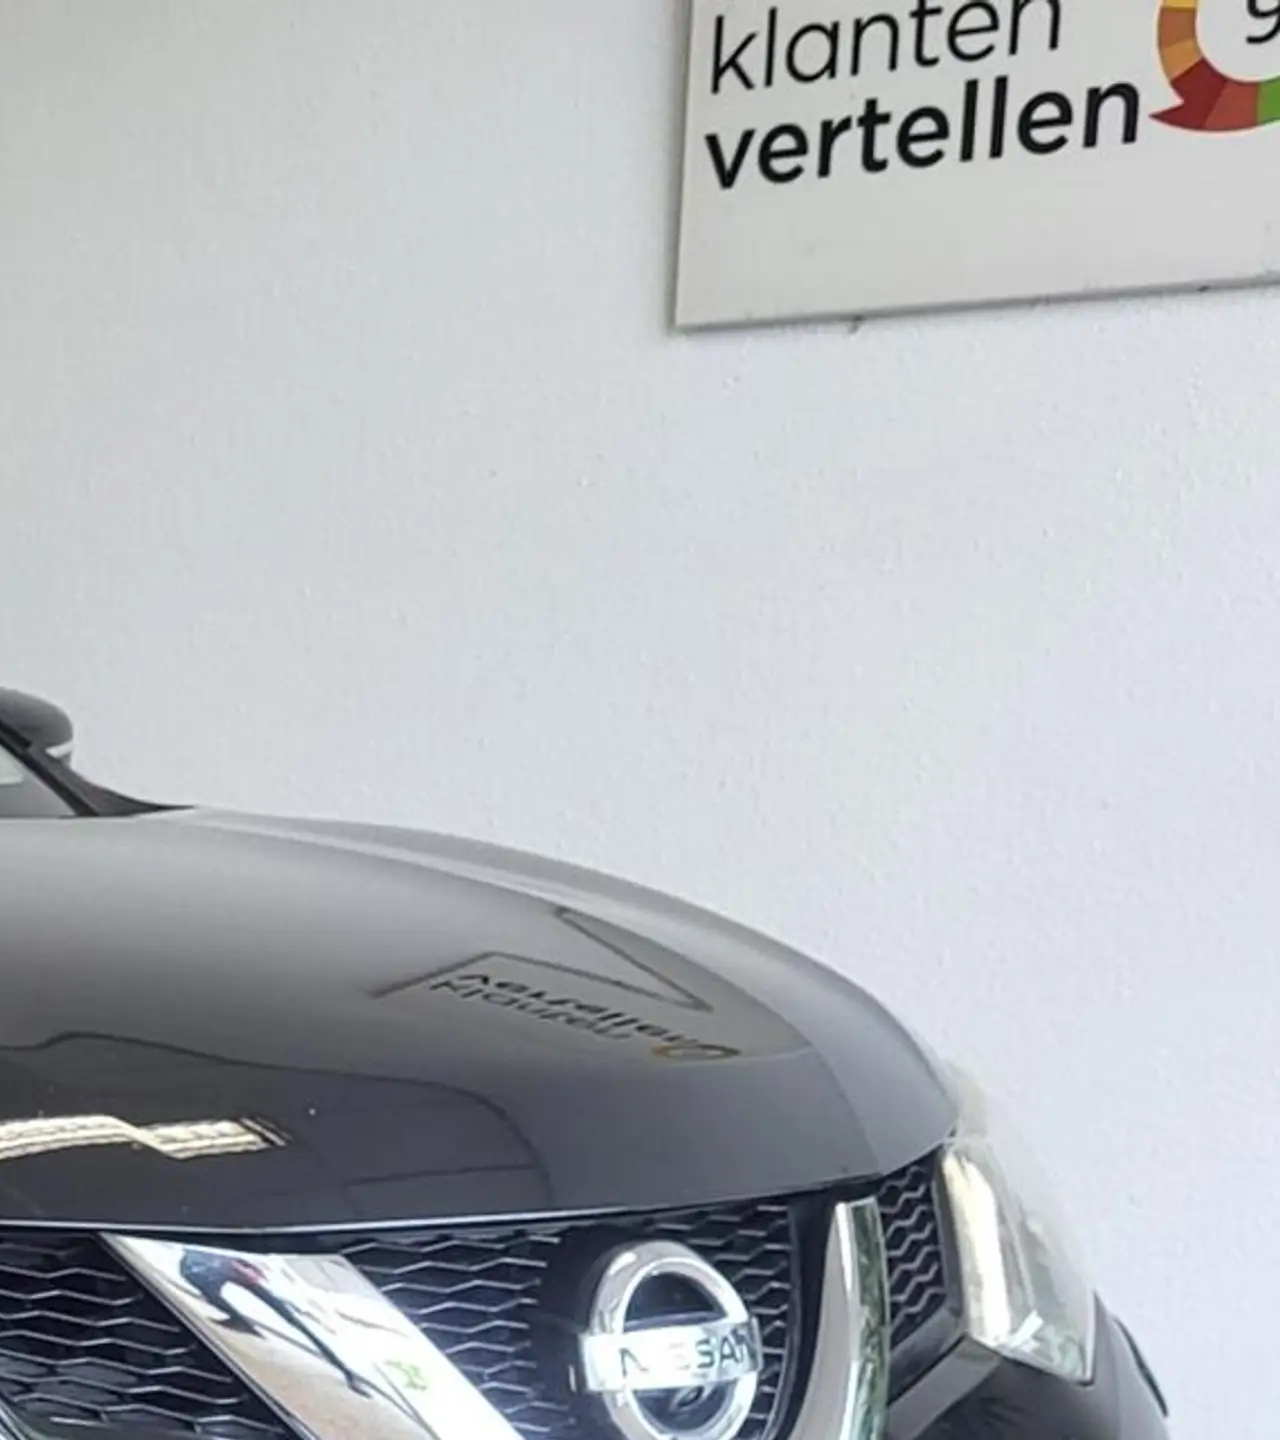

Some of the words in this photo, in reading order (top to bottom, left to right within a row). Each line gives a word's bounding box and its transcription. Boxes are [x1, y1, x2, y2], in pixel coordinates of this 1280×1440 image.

[711, 0, 1062, 95] klanten
[705, 76, 1140, 190] vertellen
[618, 1323, 757, 1379] NSSAN
